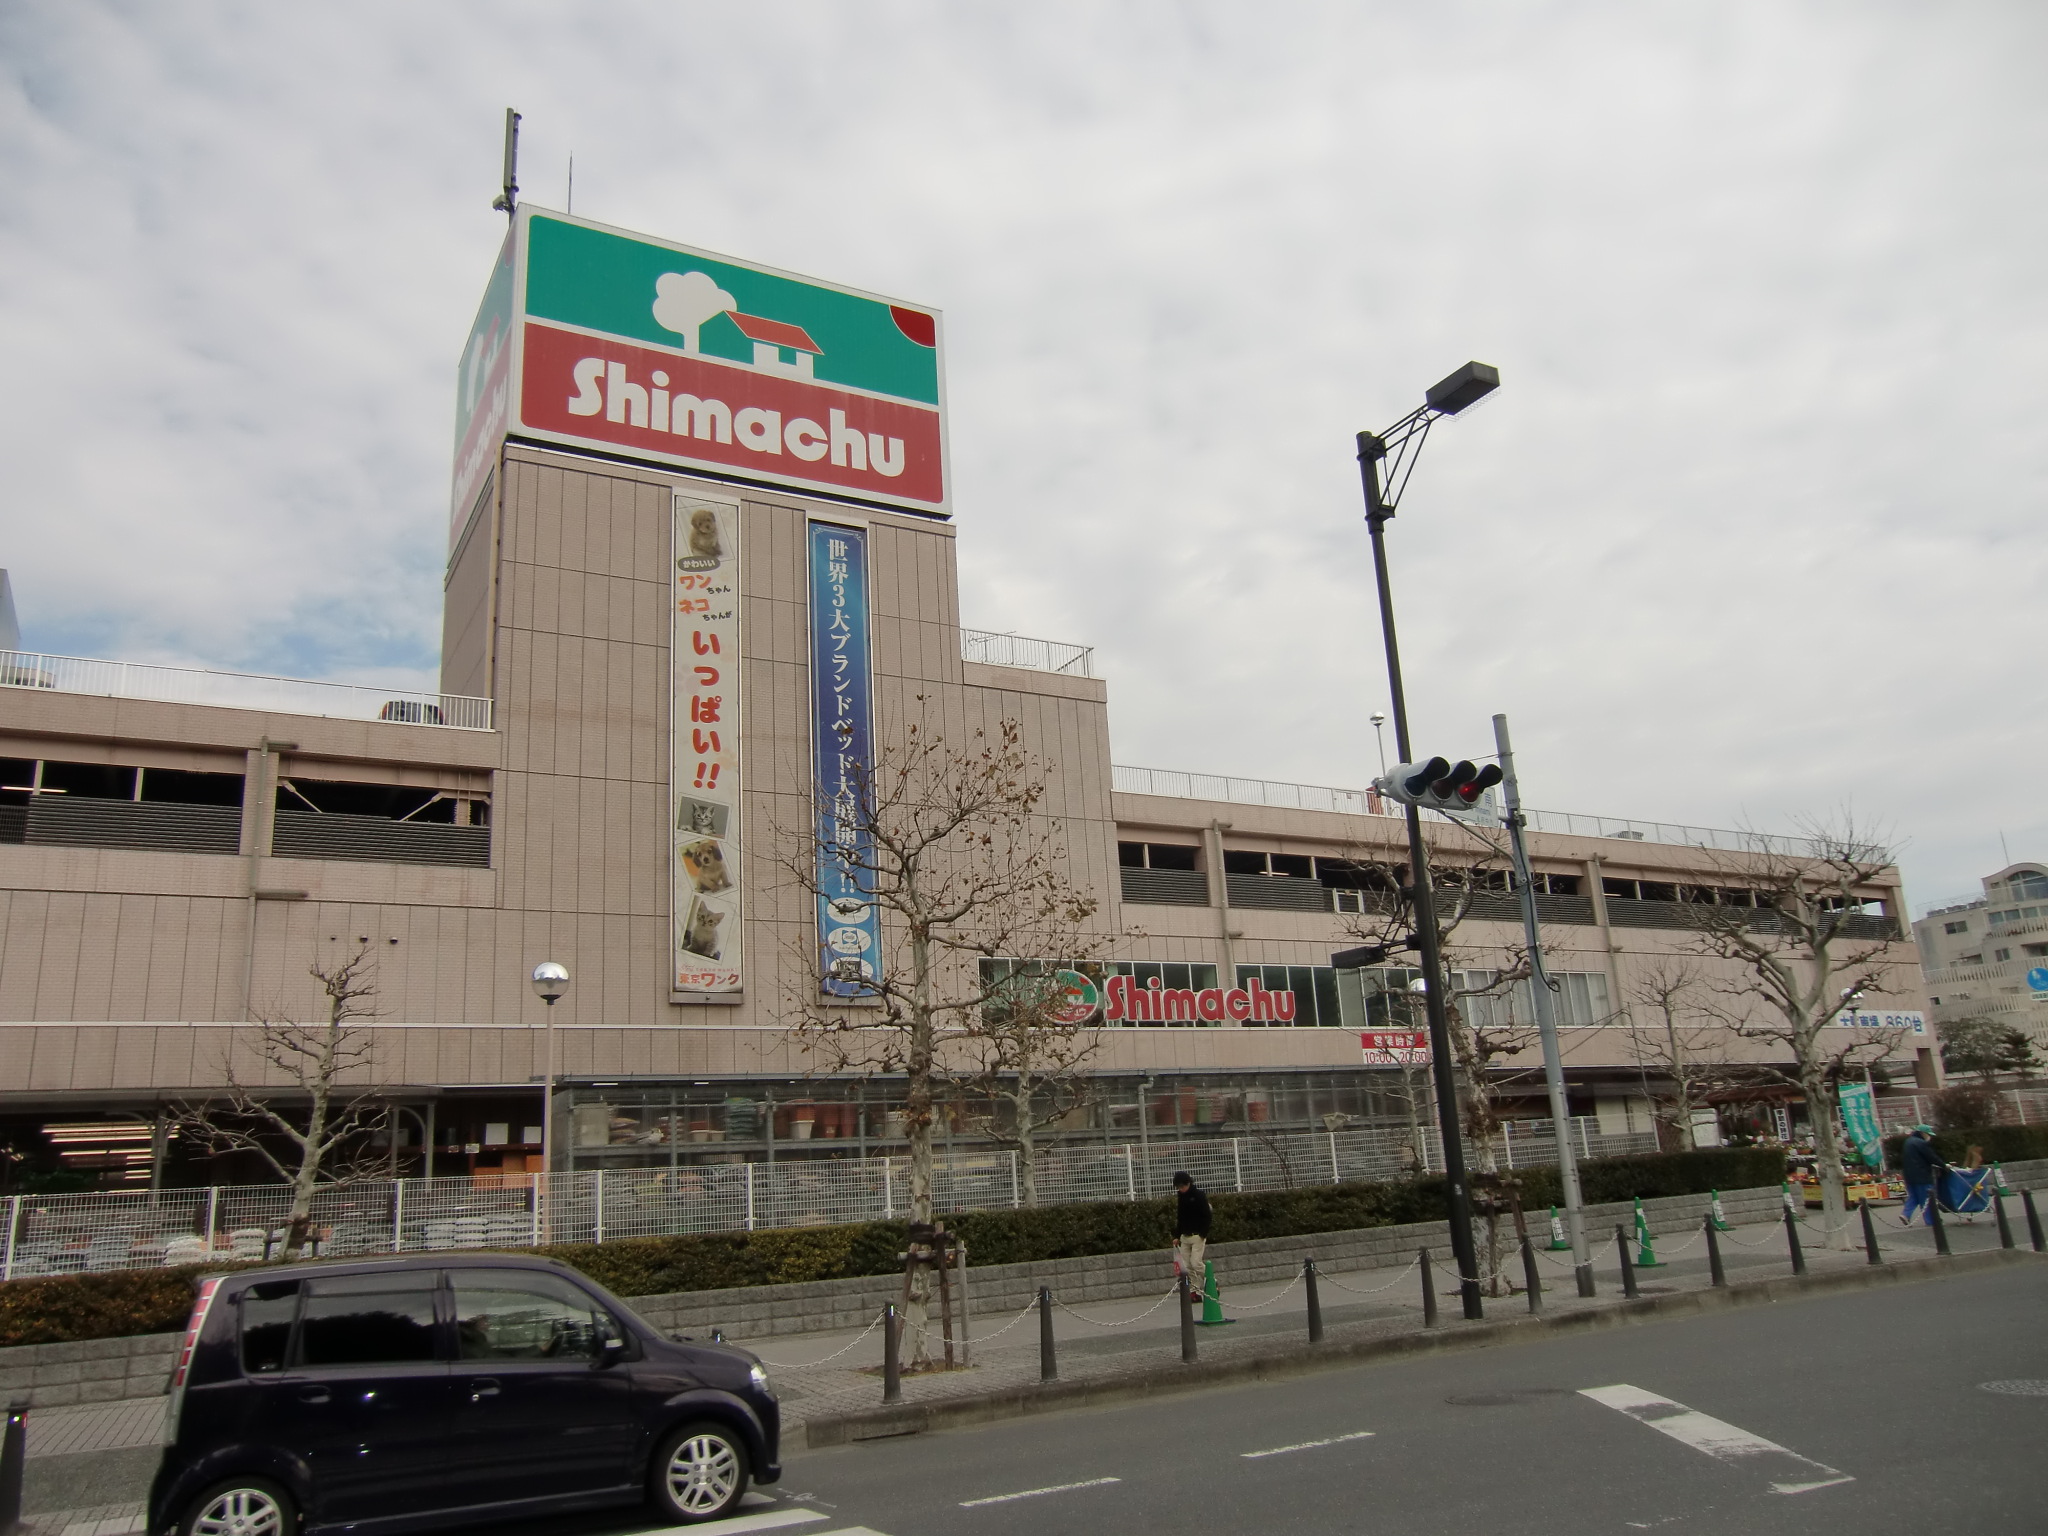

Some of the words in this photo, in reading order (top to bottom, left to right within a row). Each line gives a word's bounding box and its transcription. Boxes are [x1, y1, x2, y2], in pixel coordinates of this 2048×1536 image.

[568, 356, 905, 478] Shimachu
[683, 559, 716, 569] かわいい
[1105, 974, 1296, 1022] Shimachu
[1373, 1034, 1414, 1047] 営業時間
